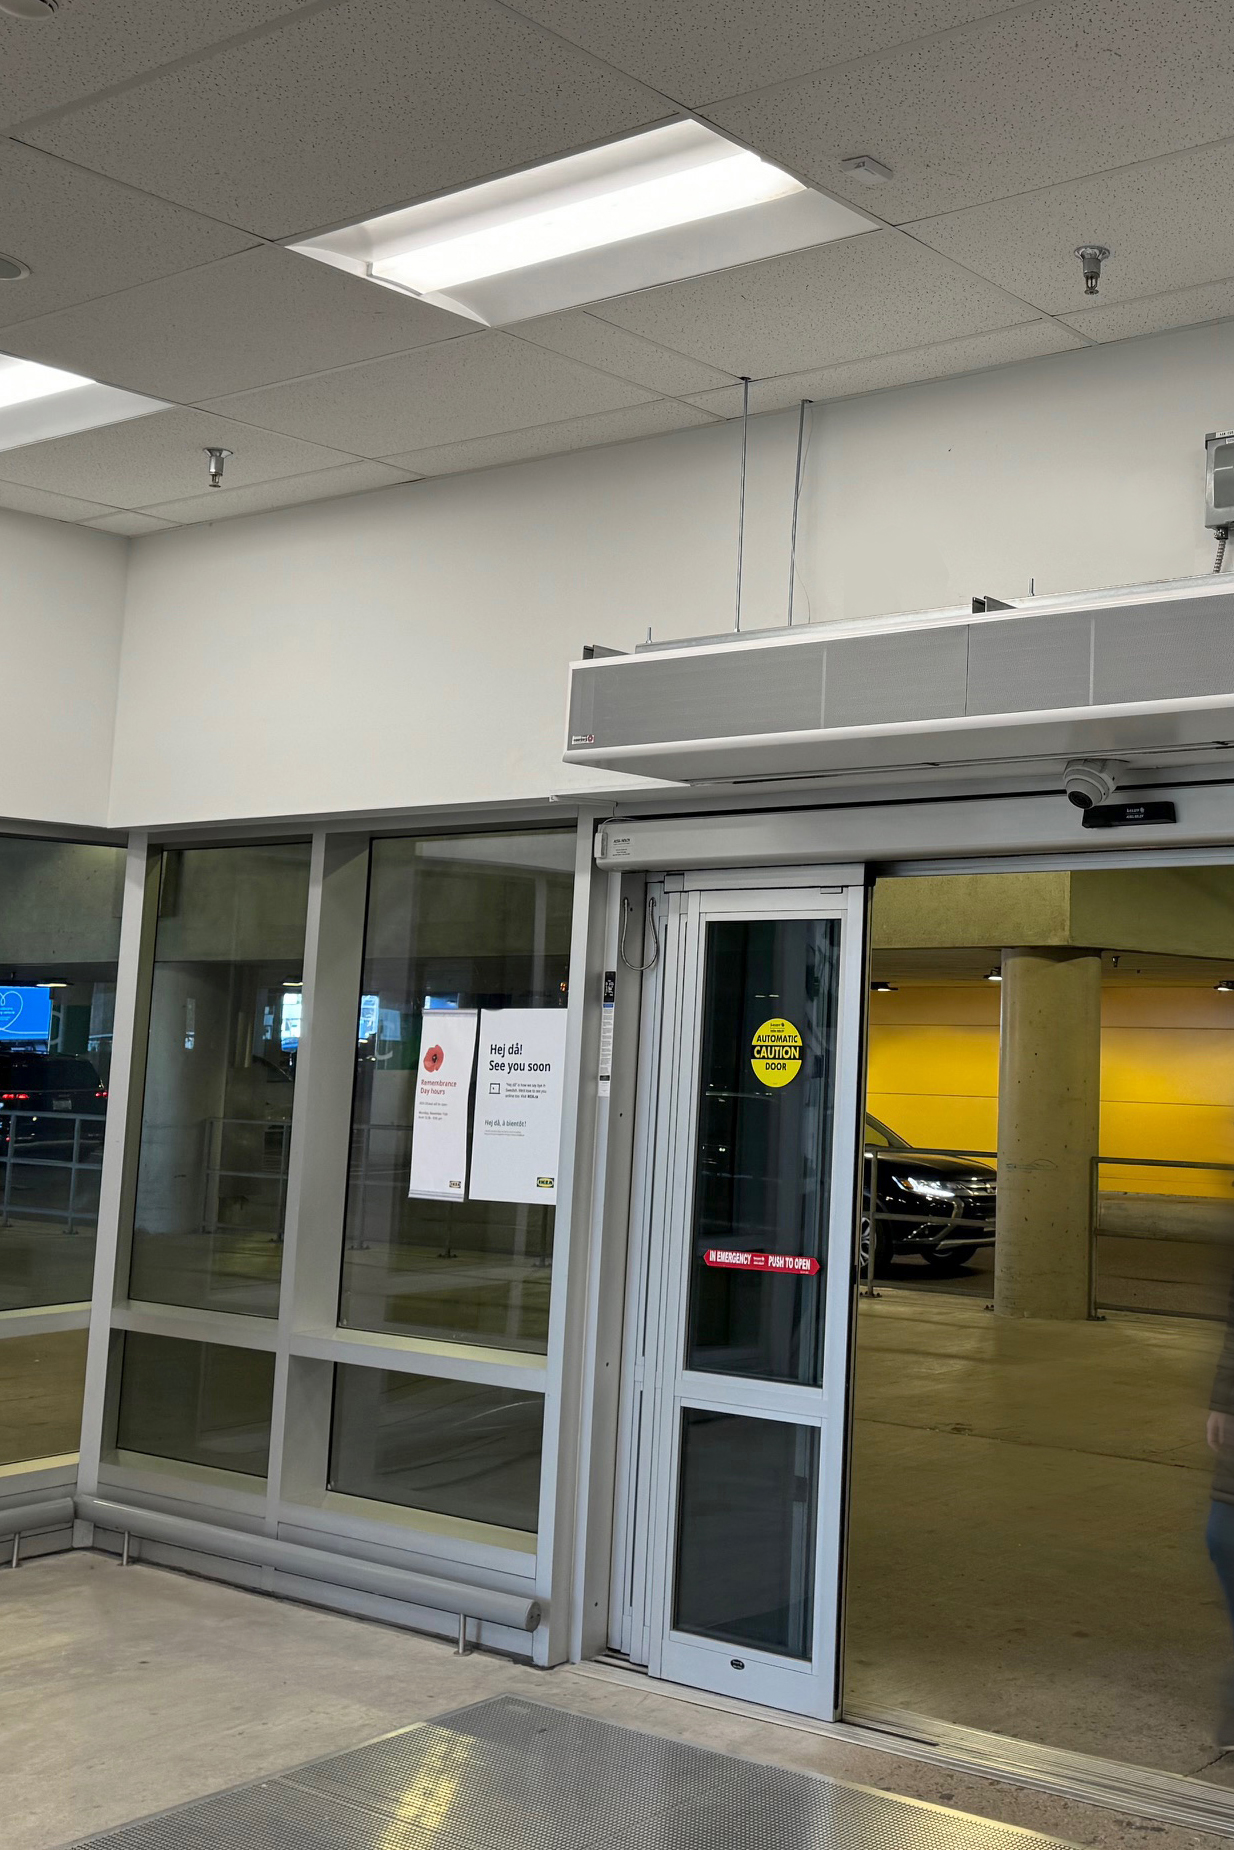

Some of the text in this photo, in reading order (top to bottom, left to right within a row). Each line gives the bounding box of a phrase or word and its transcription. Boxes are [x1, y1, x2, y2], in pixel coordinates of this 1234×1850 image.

[756, 1034, 798, 1043] AUTOMATIC
[489, 1042, 523, 1058] Hej då!
[753, 1046, 800, 1059] CAUTION
[488, 1060, 551, 1075] See you soon
[765, 1062, 787, 1071] DOOR
[420, 1079, 457, 1087] Remembrance
[420, 1087, 430, 1096] Day
[709, 1250, 716, 1262] IN
[716, 1250, 752, 1264] EMERGENCY
[768, 1255, 784, 1267] PUSH
[785, 1257, 794, 1269] TO
[794, 1258, 811, 1270] OPEN
